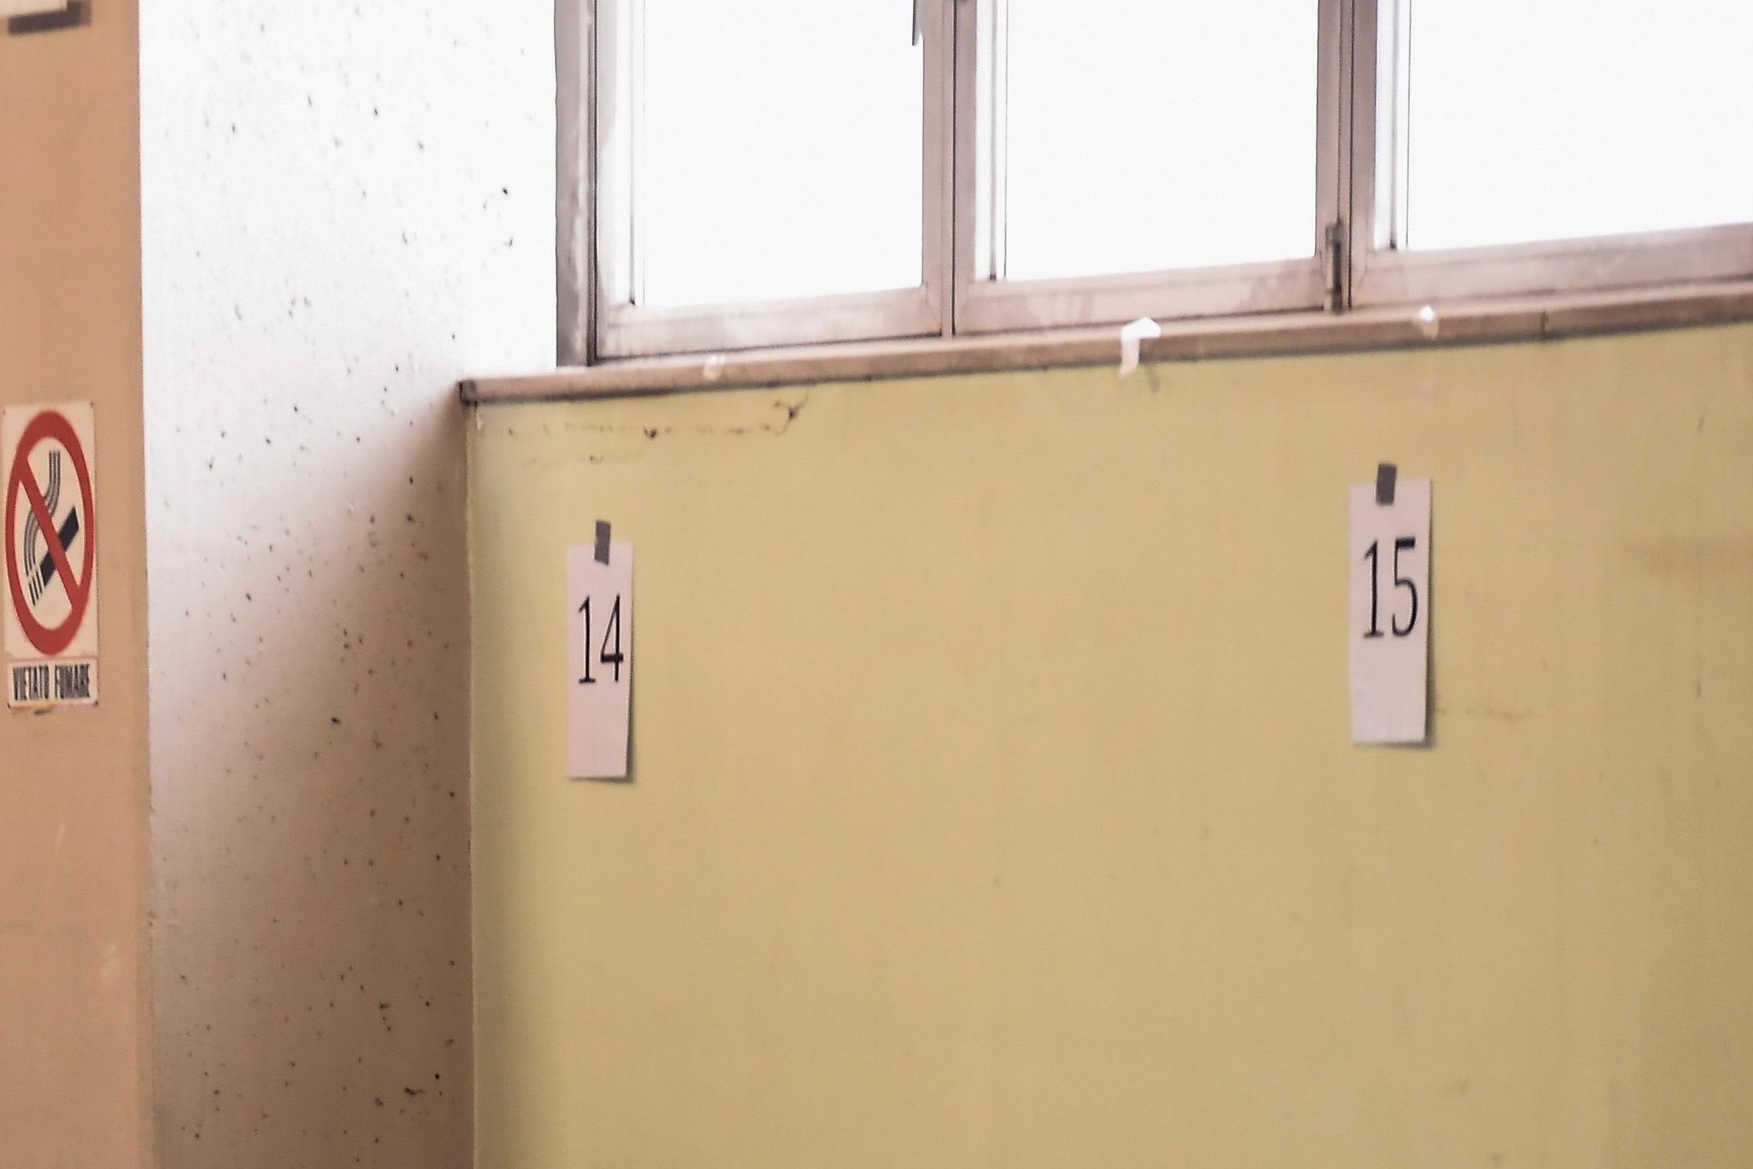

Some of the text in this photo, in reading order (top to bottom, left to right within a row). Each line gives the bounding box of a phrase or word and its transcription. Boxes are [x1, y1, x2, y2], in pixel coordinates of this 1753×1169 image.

[1363, 537, 1418, 639] 15
[12, 663, 90, 702] VIETATO FUMARE
[578, 594, 624, 684] 14
